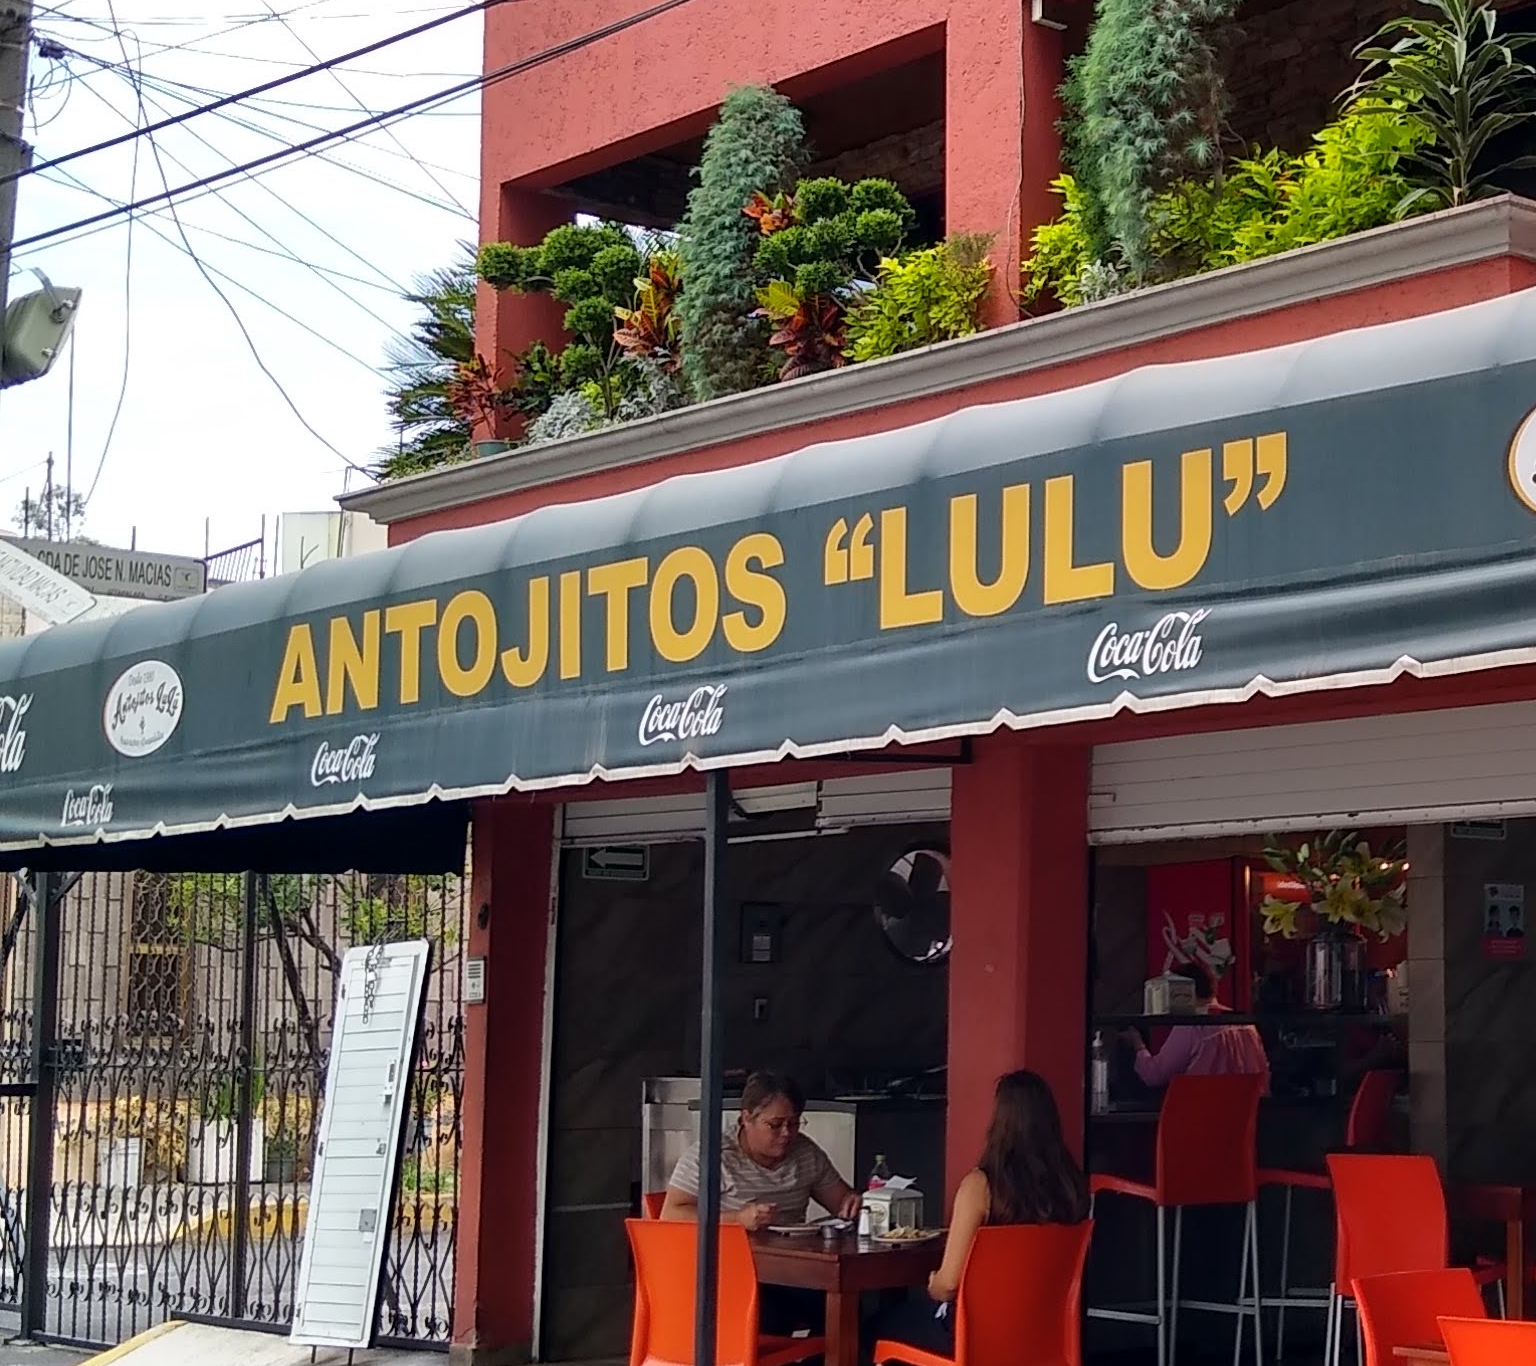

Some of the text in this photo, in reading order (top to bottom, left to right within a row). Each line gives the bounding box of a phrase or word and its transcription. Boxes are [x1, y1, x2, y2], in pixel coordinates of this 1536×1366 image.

[63, 552, 80, 577] DE
[82, 554, 112, 581] JOSE
[128, 561, 172, 588] MACIAS
[268, 532, 787, 725] ANTOJITOS
